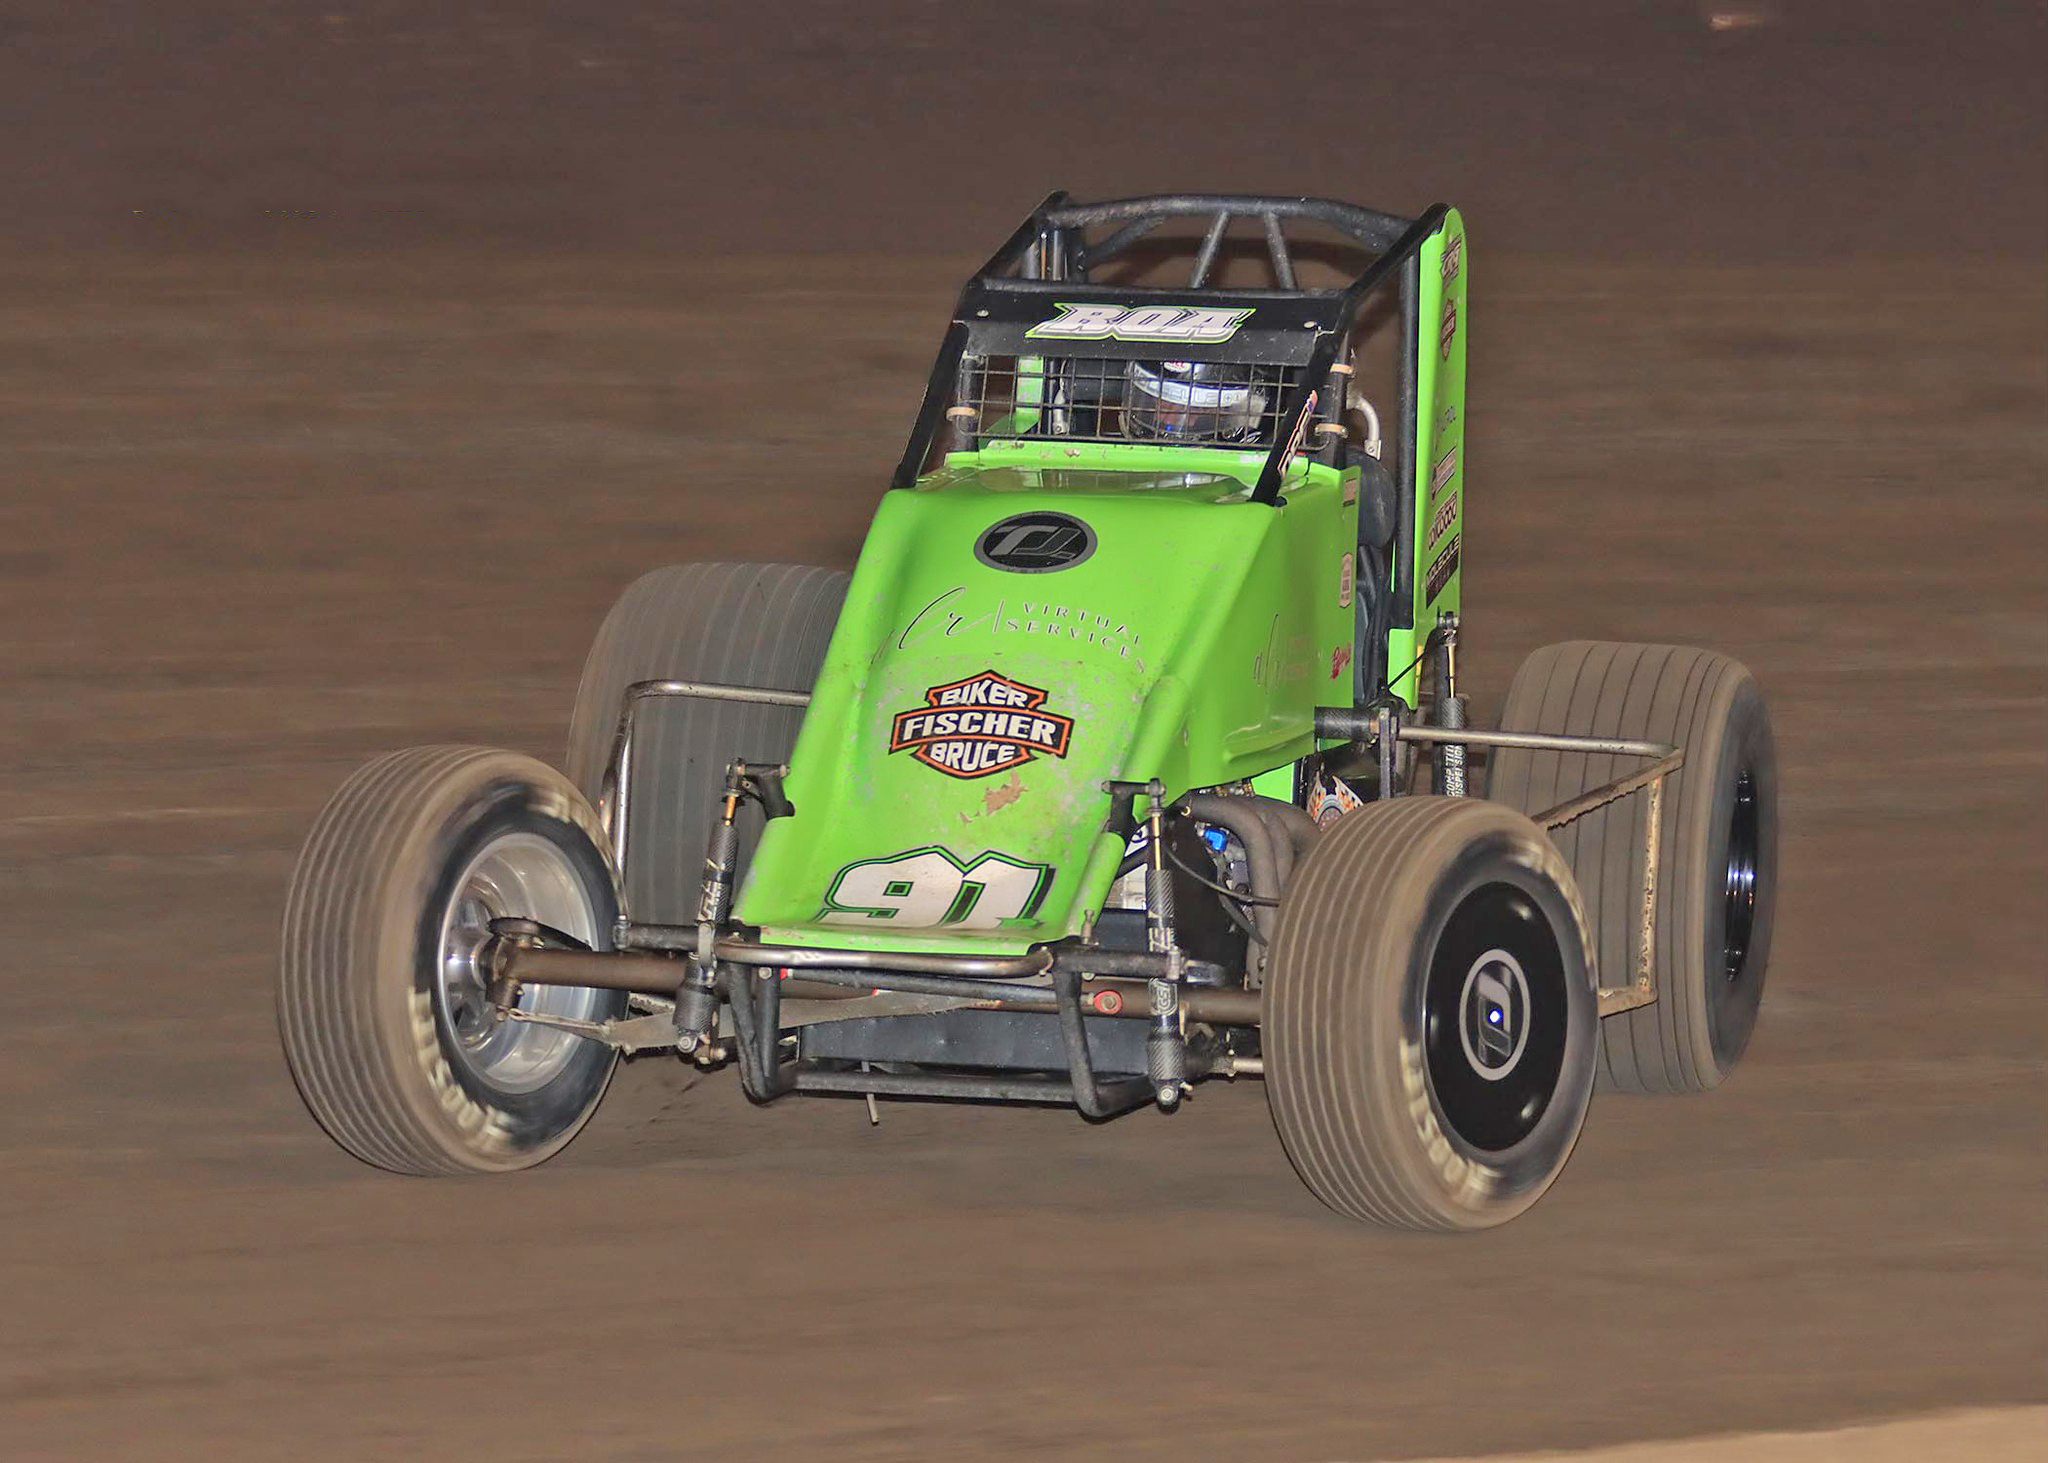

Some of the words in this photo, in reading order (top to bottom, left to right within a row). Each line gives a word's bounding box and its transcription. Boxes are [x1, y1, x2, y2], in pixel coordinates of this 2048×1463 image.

[1023, 601, 1141, 646] VIRTUAL
[940, 679, 1028, 708] BIKER
[902, 711, 1057, 746] FISCHER
[930, 741, 1016, 772] BRUCE
[814, 846, 1050, 930] 91
